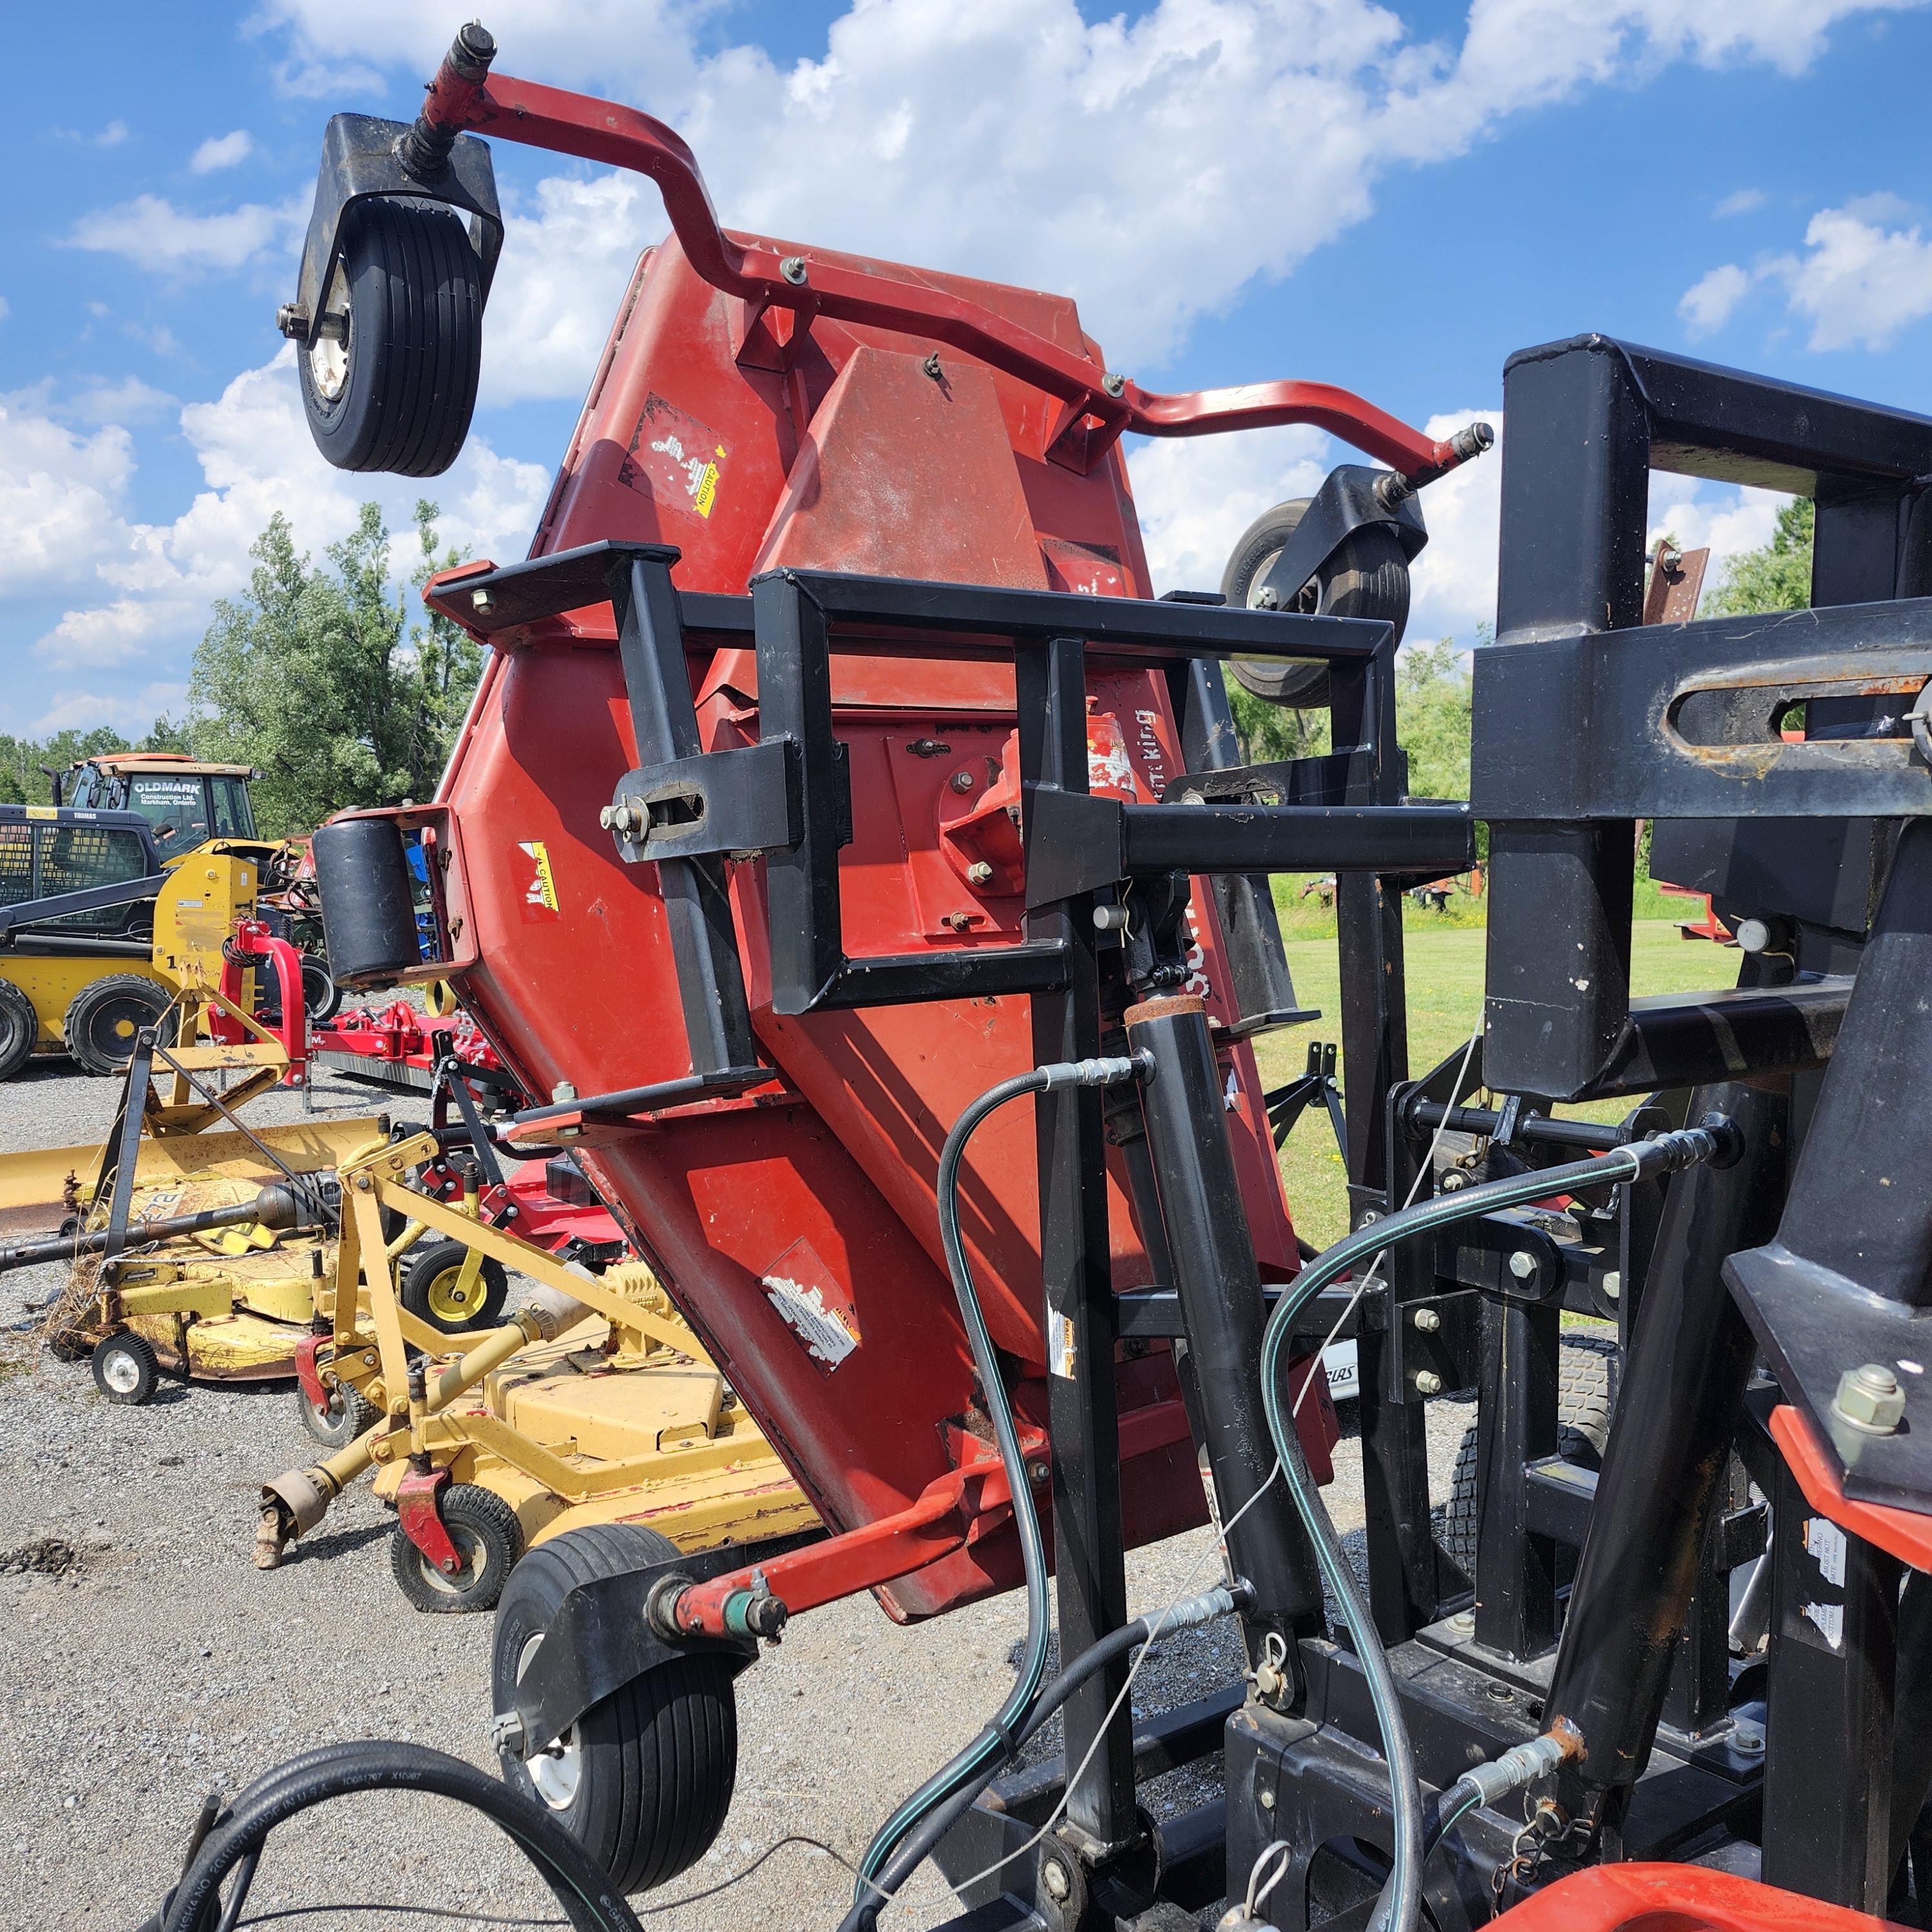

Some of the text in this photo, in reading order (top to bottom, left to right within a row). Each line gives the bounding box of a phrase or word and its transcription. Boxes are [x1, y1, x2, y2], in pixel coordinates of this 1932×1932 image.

[698, 468, 716, 506] CAUTION
[134, 782, 201, 795] OLDMARK
[539, 869, 554, 909] CAUTION
[810, 1318, 829, 1343] INSTRUCTIONS
[194, 1878, 212, 1898] NO
[246, 1805, 282, 1836] MADE
[280, 1796, 298, 1809] IN
